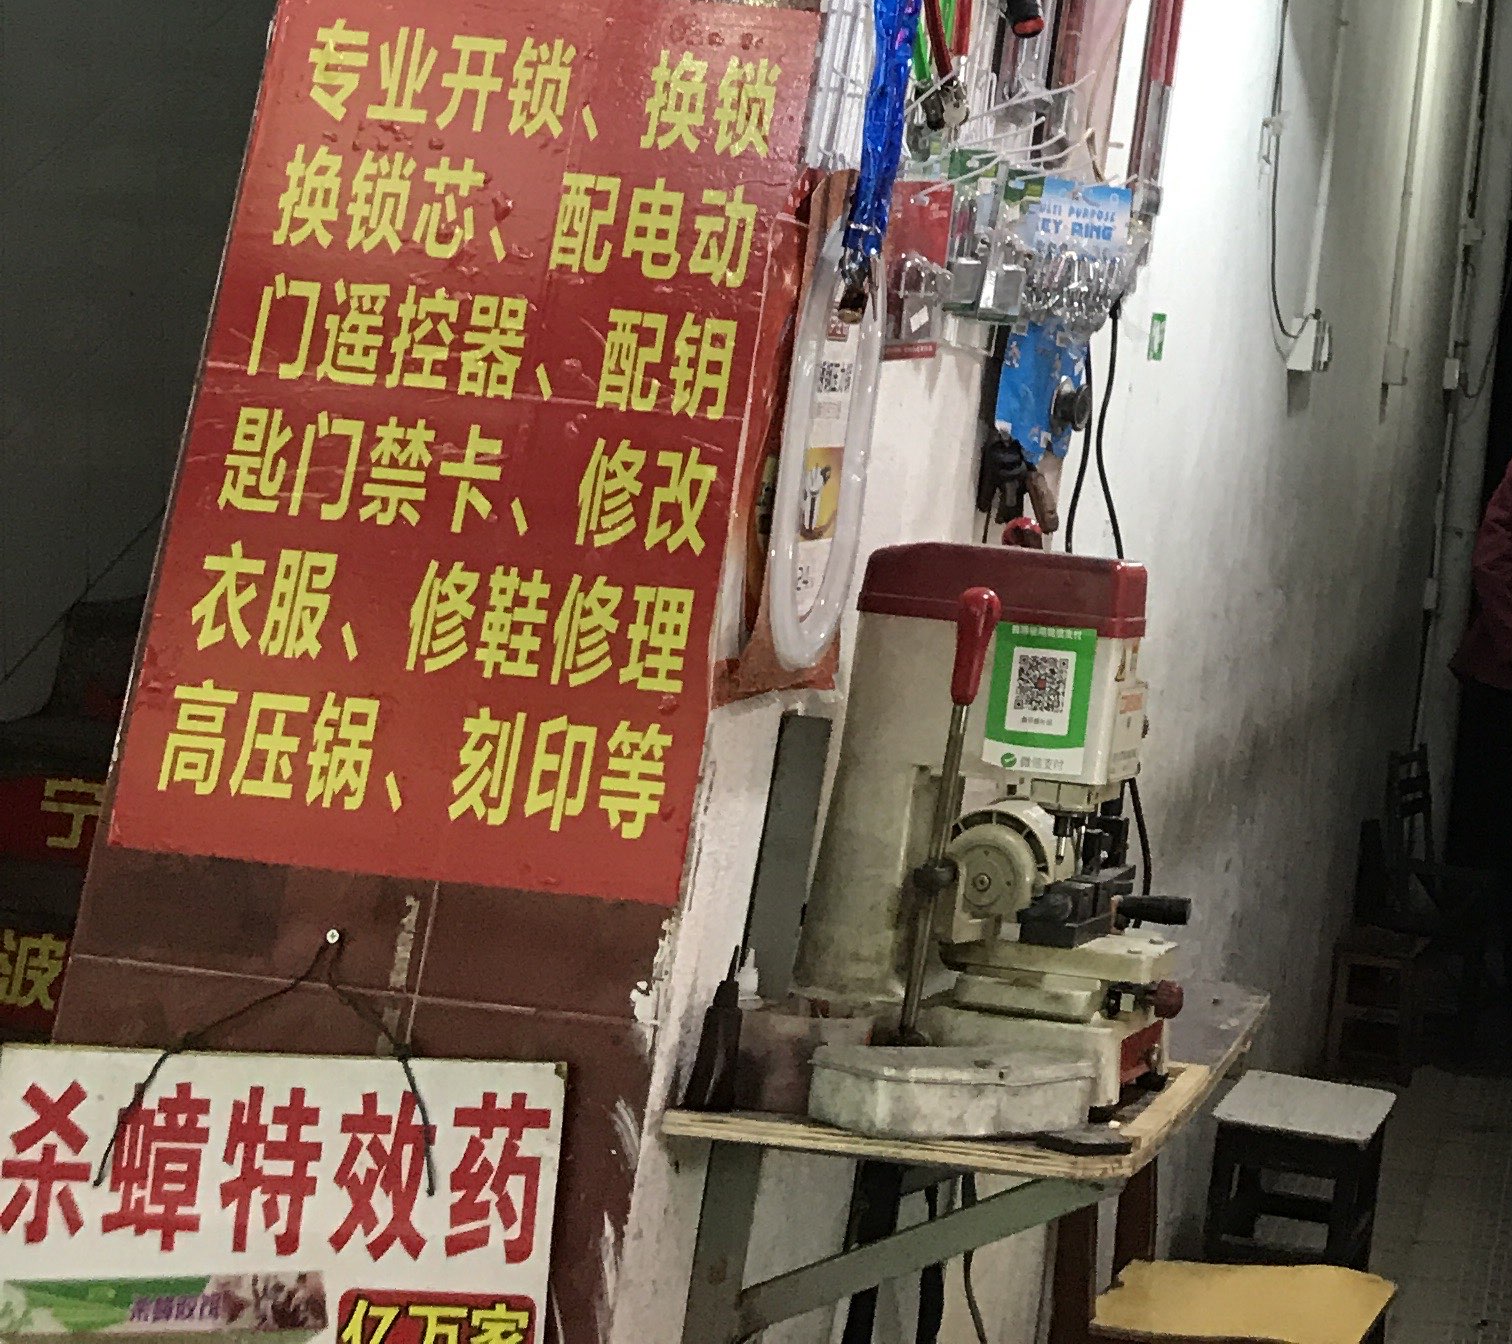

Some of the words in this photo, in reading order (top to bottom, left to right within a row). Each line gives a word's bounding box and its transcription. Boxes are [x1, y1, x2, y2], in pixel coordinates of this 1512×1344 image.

[0, 1080, 552, 1266] 杀蟑特效药
